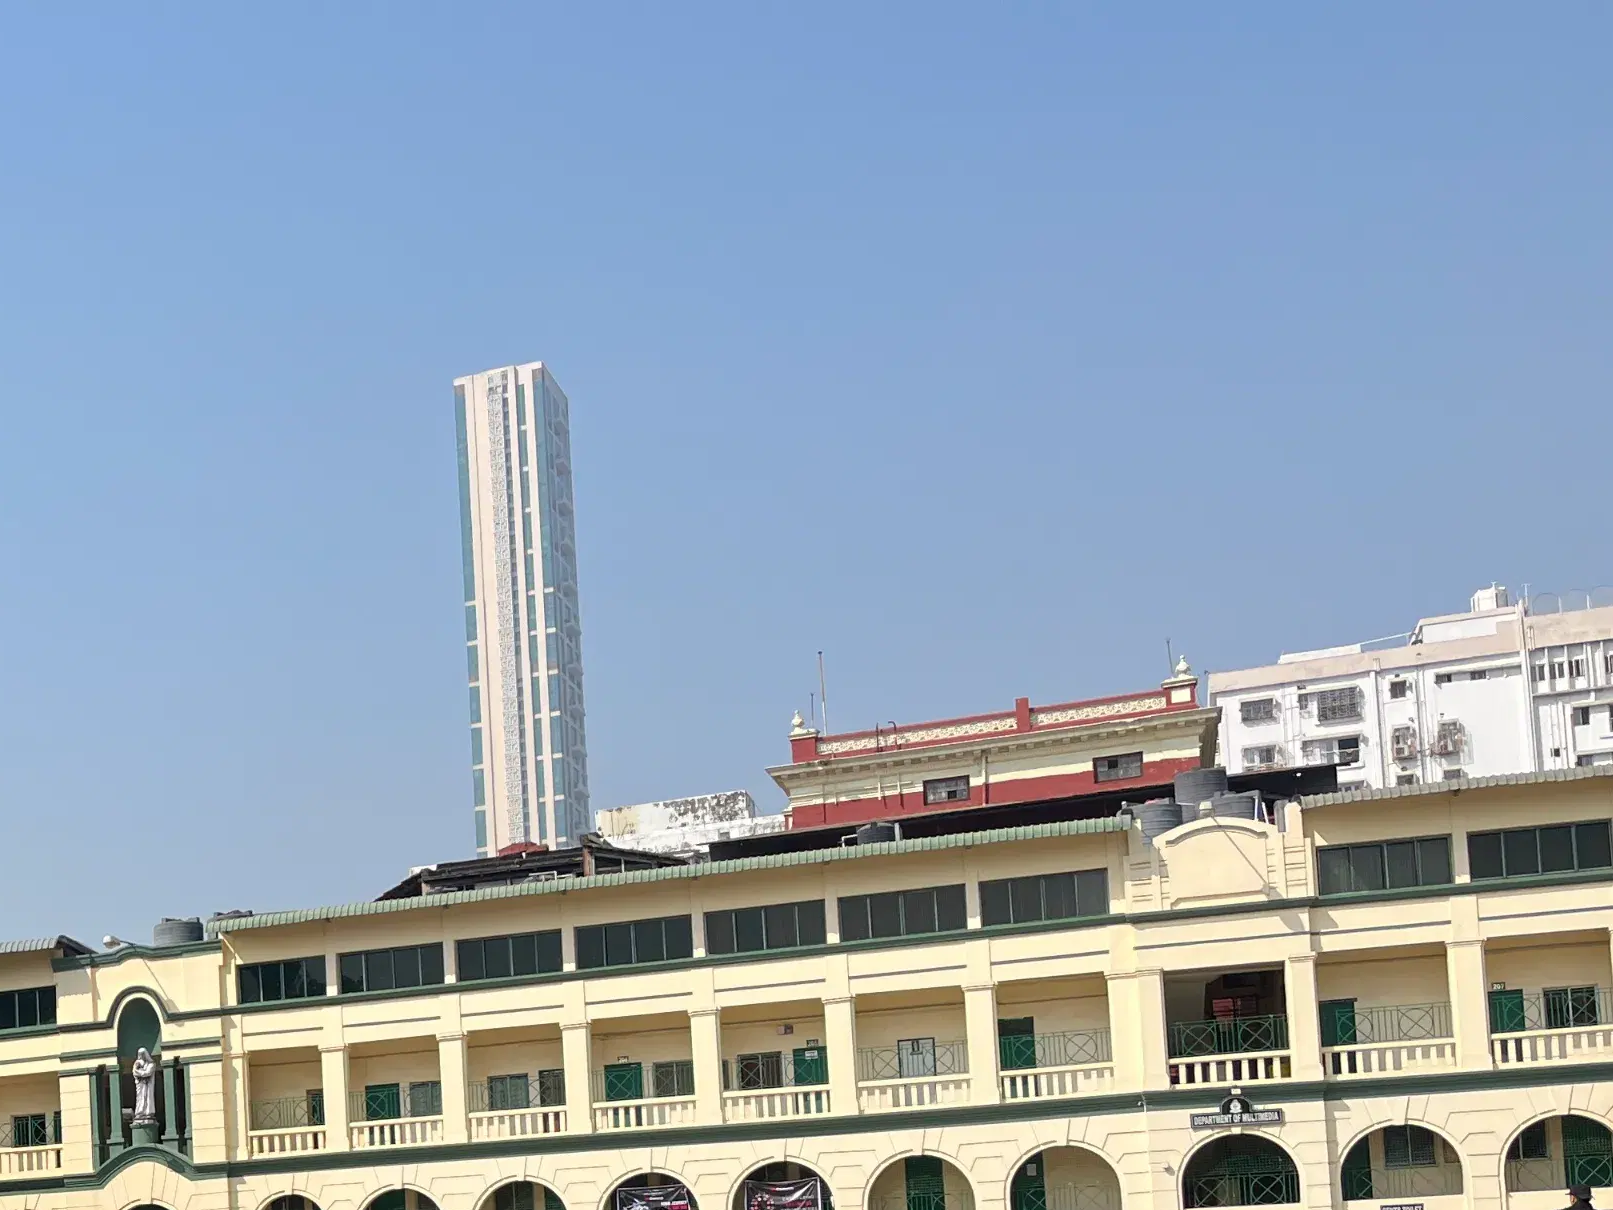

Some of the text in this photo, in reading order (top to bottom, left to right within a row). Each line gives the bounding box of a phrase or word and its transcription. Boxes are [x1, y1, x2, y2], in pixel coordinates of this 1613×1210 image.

[1193, 1111, 1279, 1126] DEPARTMENT OF MULTIMEDIA
